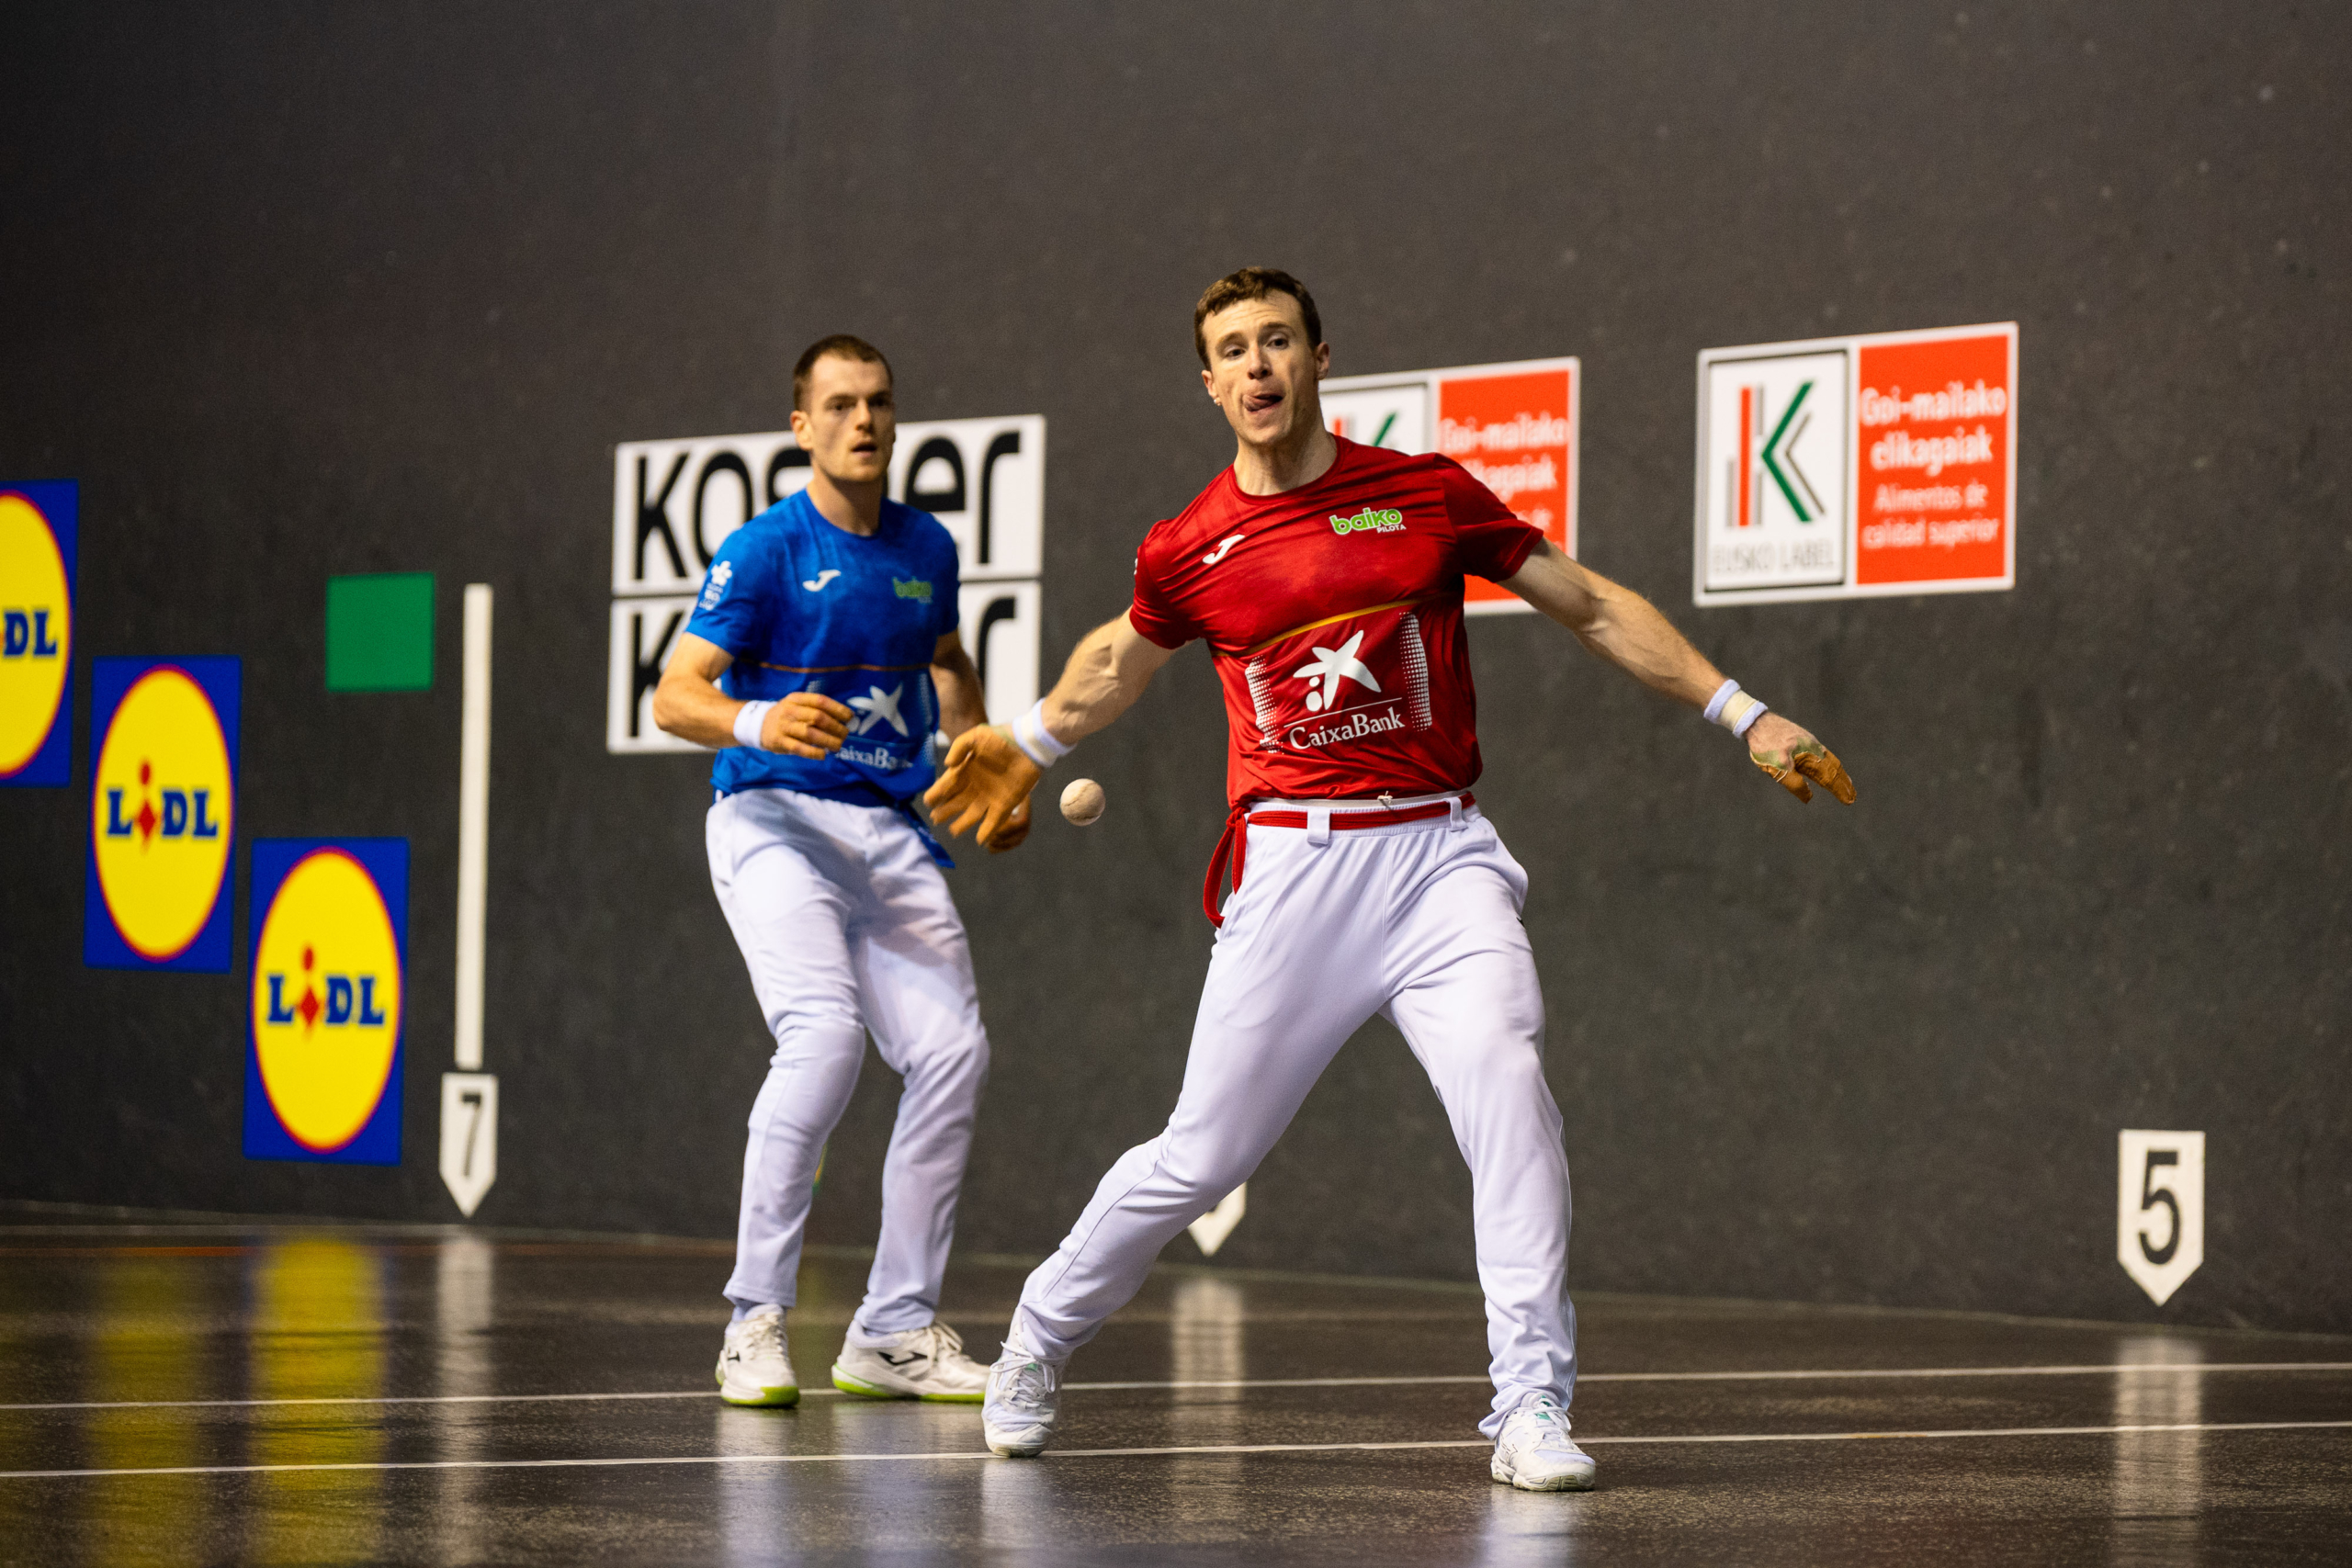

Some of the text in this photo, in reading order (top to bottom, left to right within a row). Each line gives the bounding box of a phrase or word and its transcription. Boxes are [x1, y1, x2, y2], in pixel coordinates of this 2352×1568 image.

[1329, 507, 1403, 535] baiko
[1376, 524, 1407, 534] PILOTA
[2, 609, 58, 657] DL
[1289, 706, 1406, 750] CaixaBank
[461, 1092, 482, 1179] 7
[2138, 1150, 2182, 1266] 5
